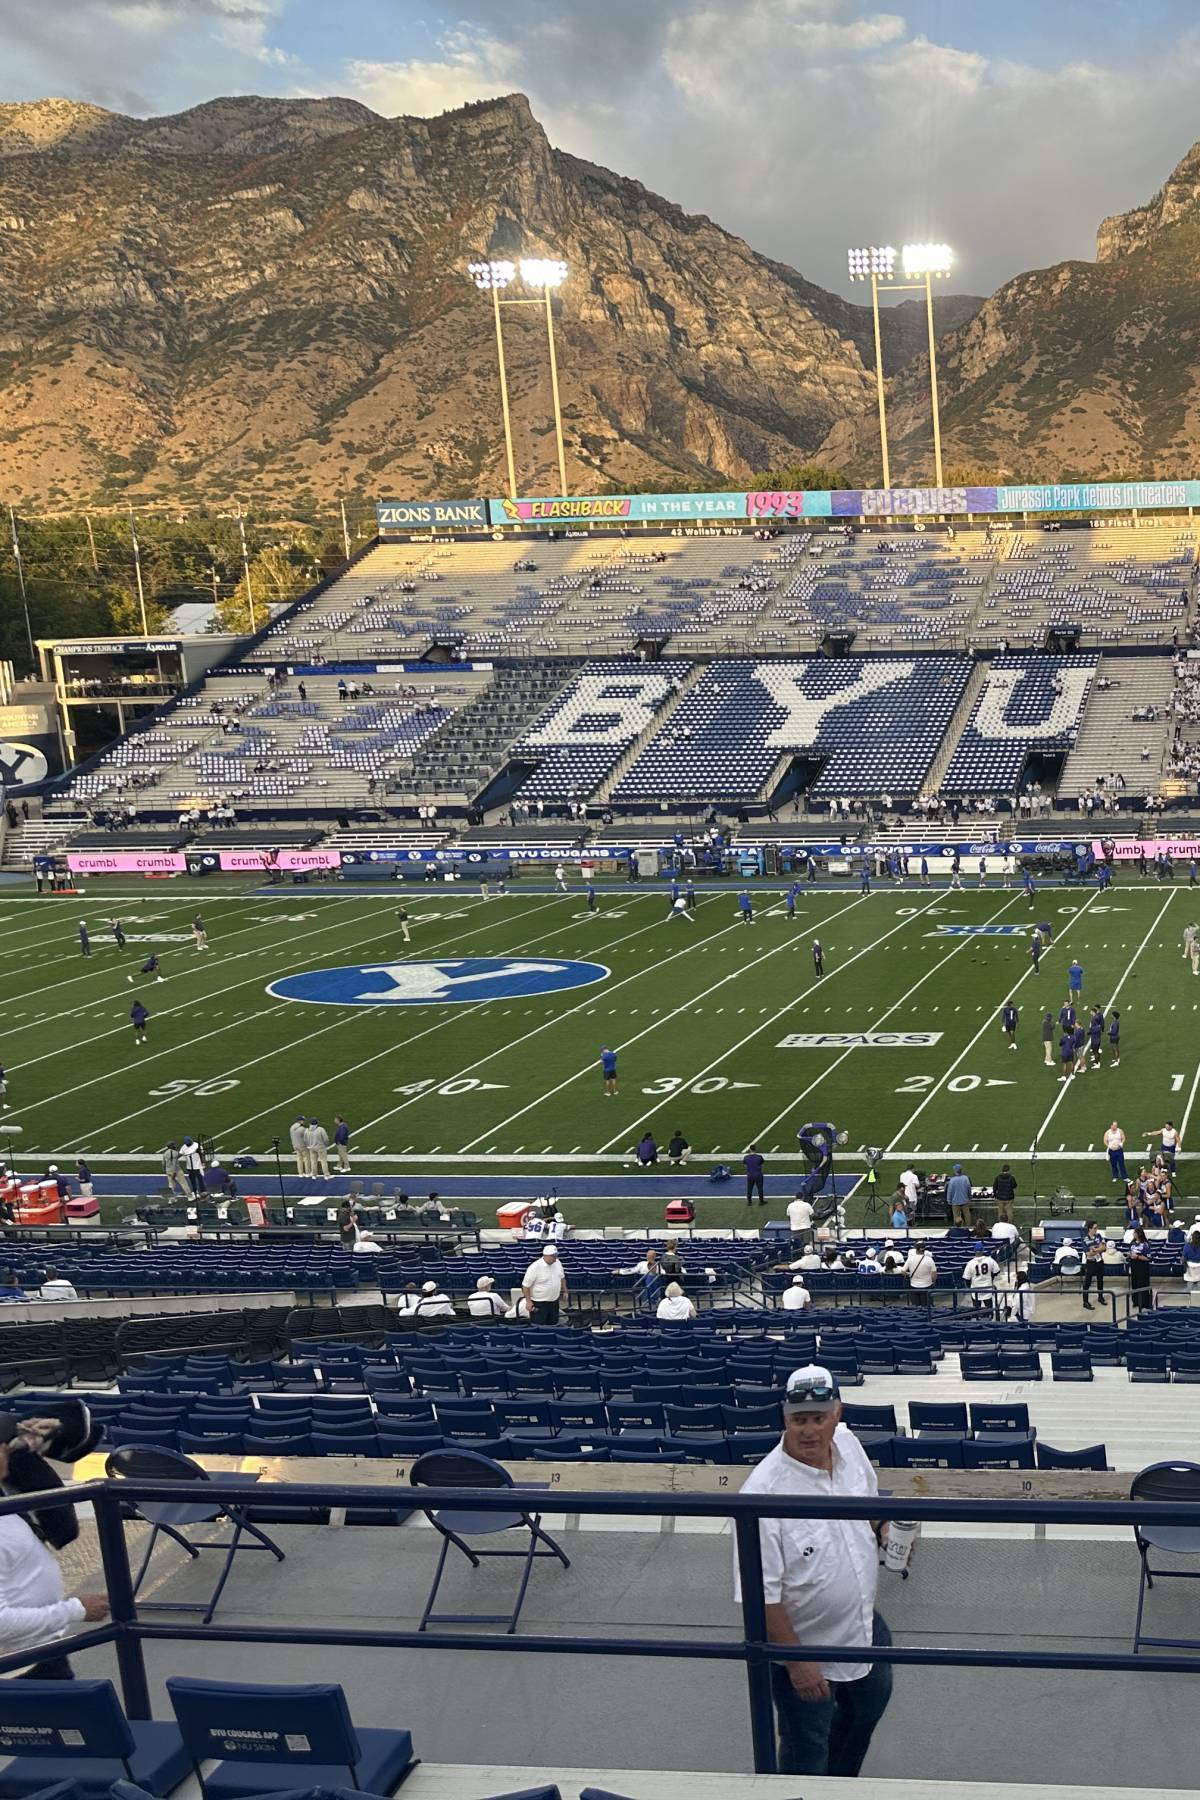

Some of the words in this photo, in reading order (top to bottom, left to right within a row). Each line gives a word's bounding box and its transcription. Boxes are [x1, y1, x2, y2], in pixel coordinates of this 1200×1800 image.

[1001, 487, 1052, 509] Jurassic
[1053, 487, 1080, 507] Park
[1083, 485, 1122, 507] debuts
[1123, 486, 1135, 505] in
[1135, 481, 1187, 504] theaters
[746, 492, 805, 517] 1993
[861, 489, 892, 515] GO
[893, 488, 968, 514] COUGS
[379, 507, 432, 523] ZIONS
[434, 504, 483, 521] BANK
[530, 499, 625, 518] FLASHBACK
[641, 502, 657, 513] IN
[659, 501, 691, 513] THE
[693, 499, 736, 511] YEAR
[1089, 519, 1105, 527] 186
[1108, 518, 1132, 527] Fleet
[671, 528, 683, 536] 42
[684, 527, 722, 537] Wallaby
[724, 526, 743, 537] Way
[53, 645, 92, 654] CHAMPIONS
[92, 644, 124, 653] TERRACE
[528, 664, 1098, 747] BYU
[0, 713, 39, 721] OUNTAIN
[509, 849, 539, 858] BYU
[541, 848, 610, 858] COUGARS
[840, 846, 861, 854] GO
[78, 858, 118, 868] crumbl
[136, 857, 176, 868] crumbl
[290, 855, 331, 866] crumbl
[815, 1034, 933, 1046] PACS
[148, 1079, 240, 1096] 50
[393, 1078, 481, 1096] 40
[642, 1077, 731, 1094] 30
[895, 1075, 982, 1093] 20
[974, 1263, 989, 1277] 18
[395, 1468, 405, 1479] 14
[551, 1473, 561, 1484] 13
[718, 1476, 728, 1486] 12
[1022, 1480, 1032, 1491] 10
[209, 1728, 226, 1737] BYU
[226, 1729, 263, 1739] COUGARS
[263, 1731, 279, 1740] APP
